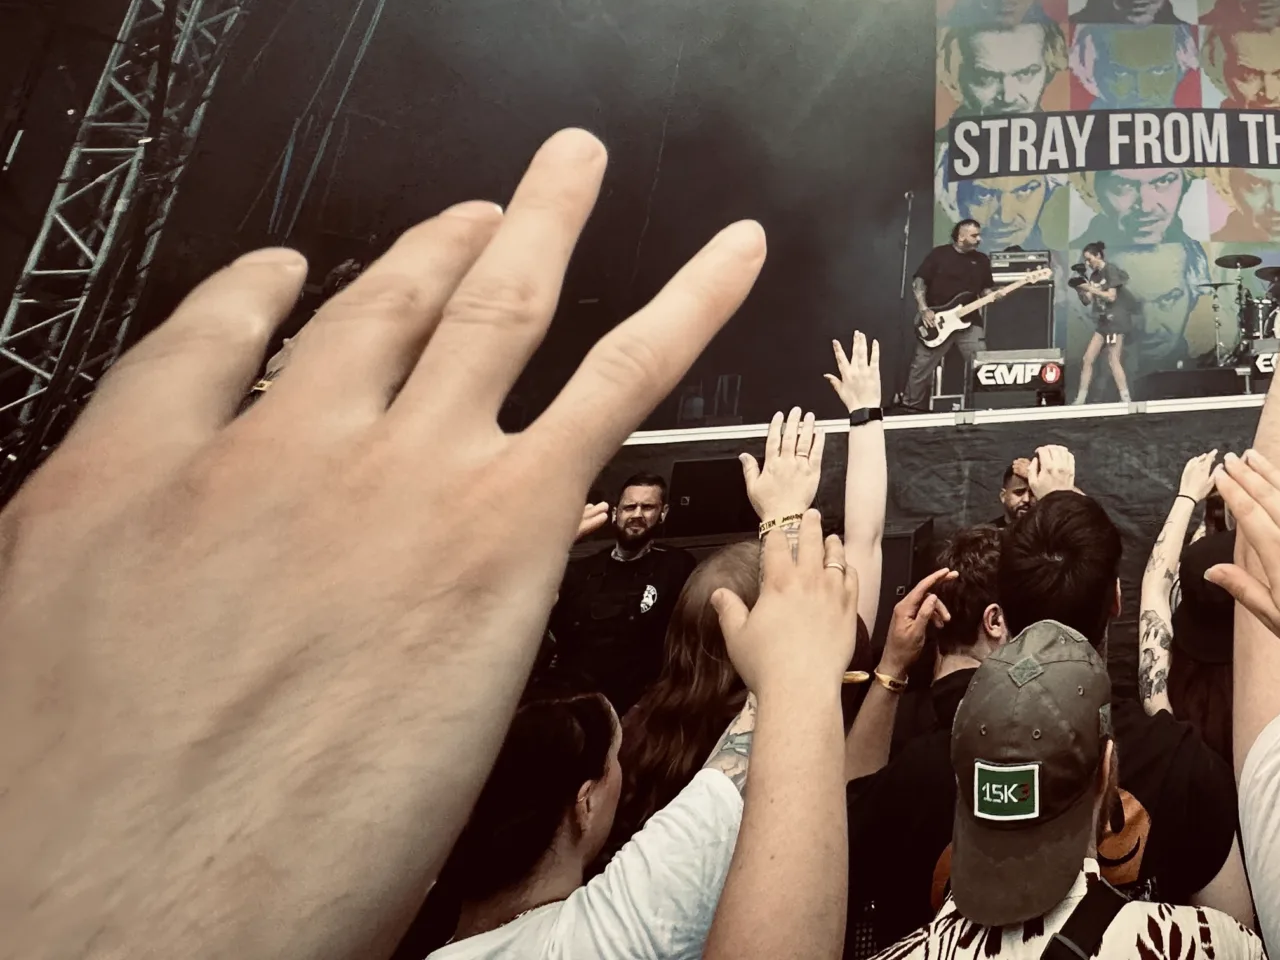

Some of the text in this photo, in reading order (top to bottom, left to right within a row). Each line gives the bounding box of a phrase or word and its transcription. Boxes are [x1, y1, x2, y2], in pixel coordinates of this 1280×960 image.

[952, 114, 1096, 176] STRAY
[1107, 111, 1230, 166] FROM
[977, 363, 1042, 386] EMP
